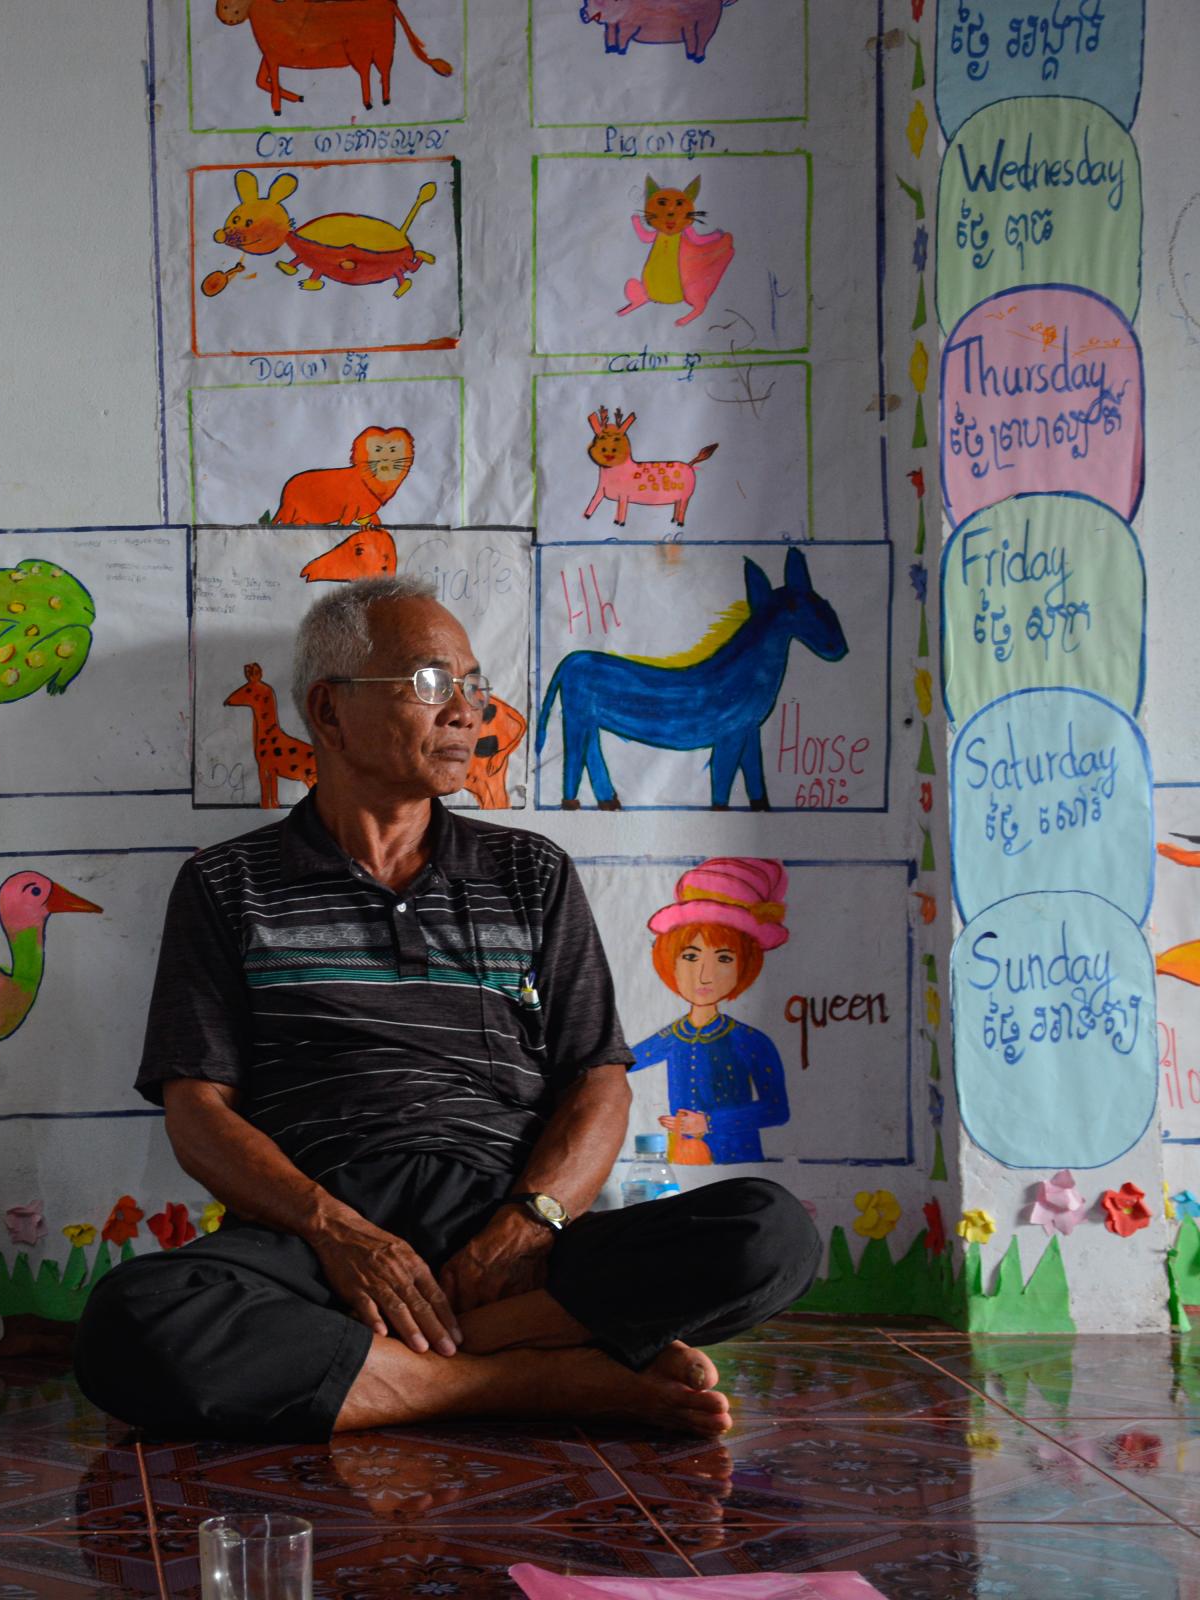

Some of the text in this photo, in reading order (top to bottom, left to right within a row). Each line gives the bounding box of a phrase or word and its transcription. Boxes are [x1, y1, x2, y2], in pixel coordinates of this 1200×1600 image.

[256, 131, 294, 157] Ox
[604, 126, 637, 160] Pig
[958, 125, 1124, 211] Wednesday
[608, 344, 648, 373] Cat
[946, 326, 1110, 424] Thursday
[560, 564, 621, 634] Hh
[962, 519, 1074, 608] Friday
[778, 703, 870, 775] Horse
[966, 722, 1118, 799] Saturday
[968, 920, 1118, 1017] Sunday
[784, 992, 889, 1071] queen
